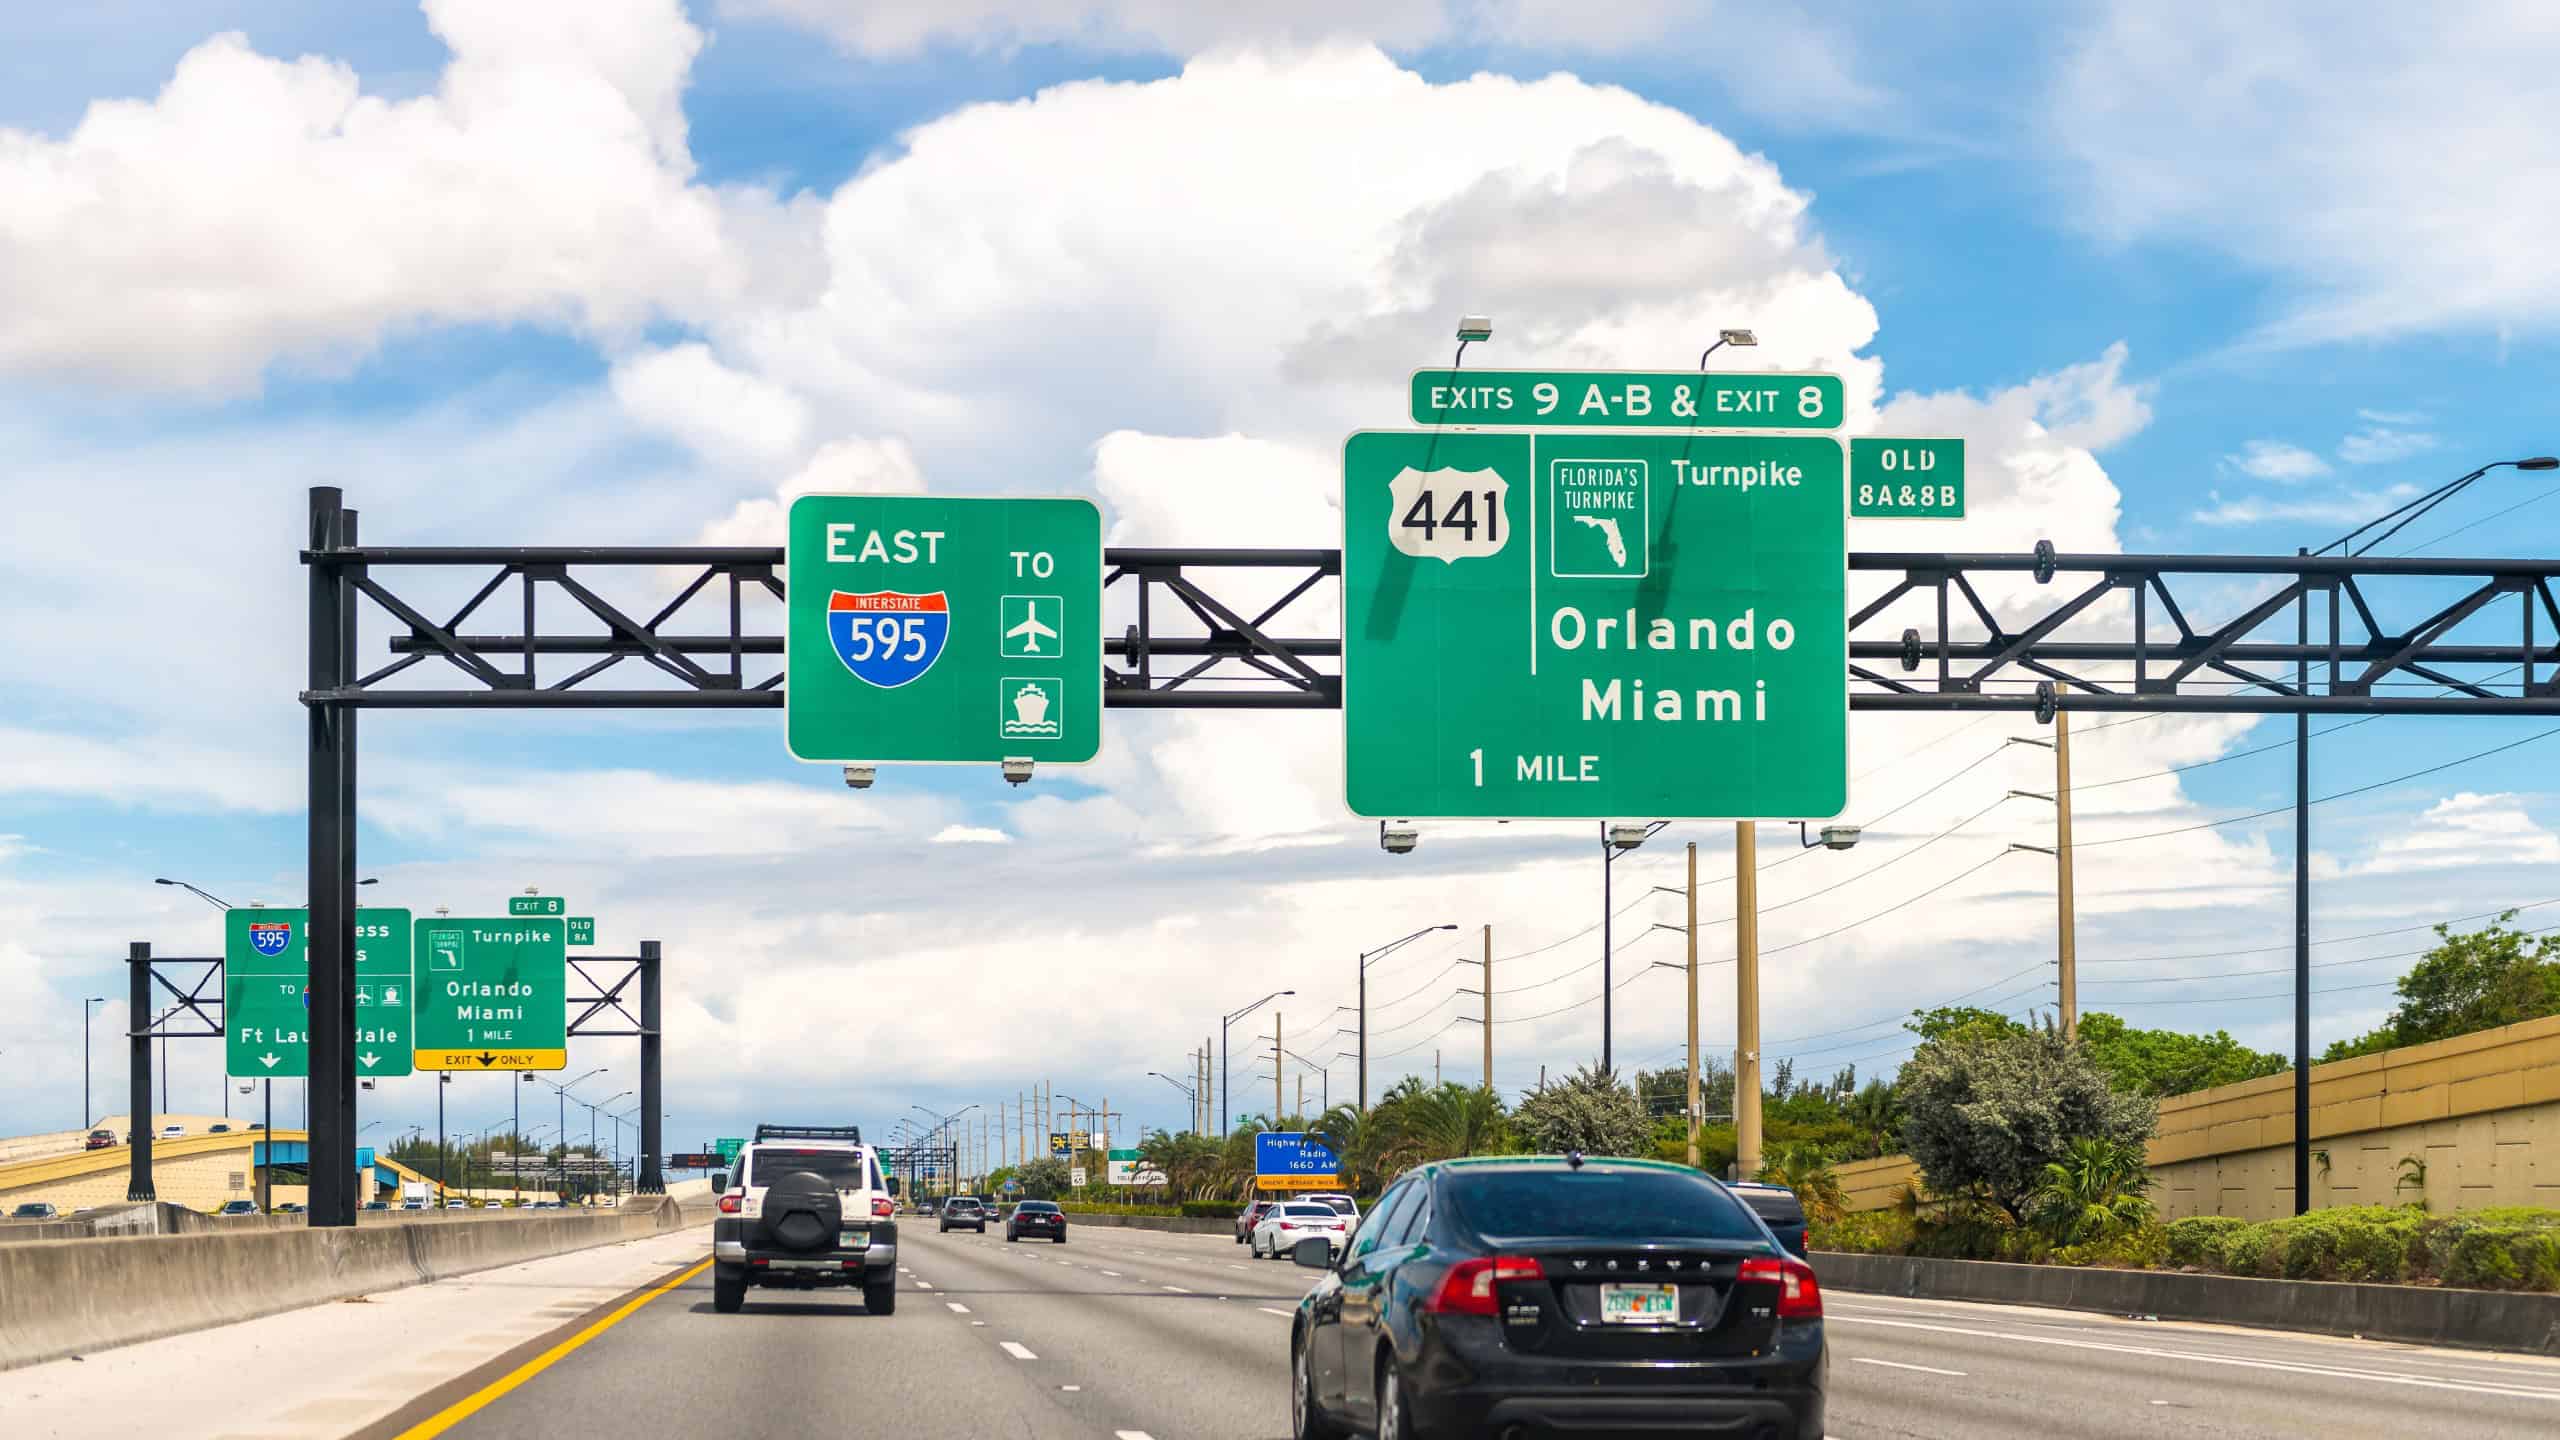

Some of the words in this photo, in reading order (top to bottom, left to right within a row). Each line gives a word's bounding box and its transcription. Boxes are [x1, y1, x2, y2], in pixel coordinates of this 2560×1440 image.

[1432, 387, 1513, 409] EXITS
[1533, 383, 1558, 415] 9
[1579, 384, 1652, 415] A-B
[1671, 385, 1697, 416] &
[1717, 390, 1779, 412] EXIT
[1798, 386, 1823, 418] 8
[1882, 450, 1935, 470] OLD
[1561, 468, 1637, 486] FLORIDA'S
[1671, 460, 1802, 492] Turnpike
[1565, 491, 1634, 508] TURNPIKE
[1859, 485, 1955, 506] 8A&8B
[1402, 491, 1496, 541] 441
[827, 523, 944, 563] EAST
[1010, 552, 1054, 578] TO
[854, 597, 921, 611] INTERSTATE
[1552, 607, 1794, 650] Orlando
[852, 618, 926, 661] 595
[1583, 679, 1765, 720] Miami
[1471, 749, 1482, 786] 1
[1518, 756, 1599, 781] MILE
[515, 901, 540, 911] EXIT
[547, 900, 558, 913] 8
[570, 921, 591, 930] OLD
[257, 931, 285, 948] 595
[472, 929, 552, 945] Turnpike
[279, 984, 296, 995] TO
[446, 980, 533, 997] Orlando
[457, 1005, 523, 1020] Miami
[241, 1027, 263, 1044] Ft
[275, 1027, 398, 1044] Laudale
[467, 1028, 474, 1042] 1
[483, 1030, 513, 1041] MILE
[445, 1055, 472, 1065] EXIT
[500, 1055, 534, 1065] ONLY
[1299, 1149, 1327, 1158] Radio
[1289, 1160, 1314, 1170] 1660
[1320, 1160, 1338, 1170] AM
